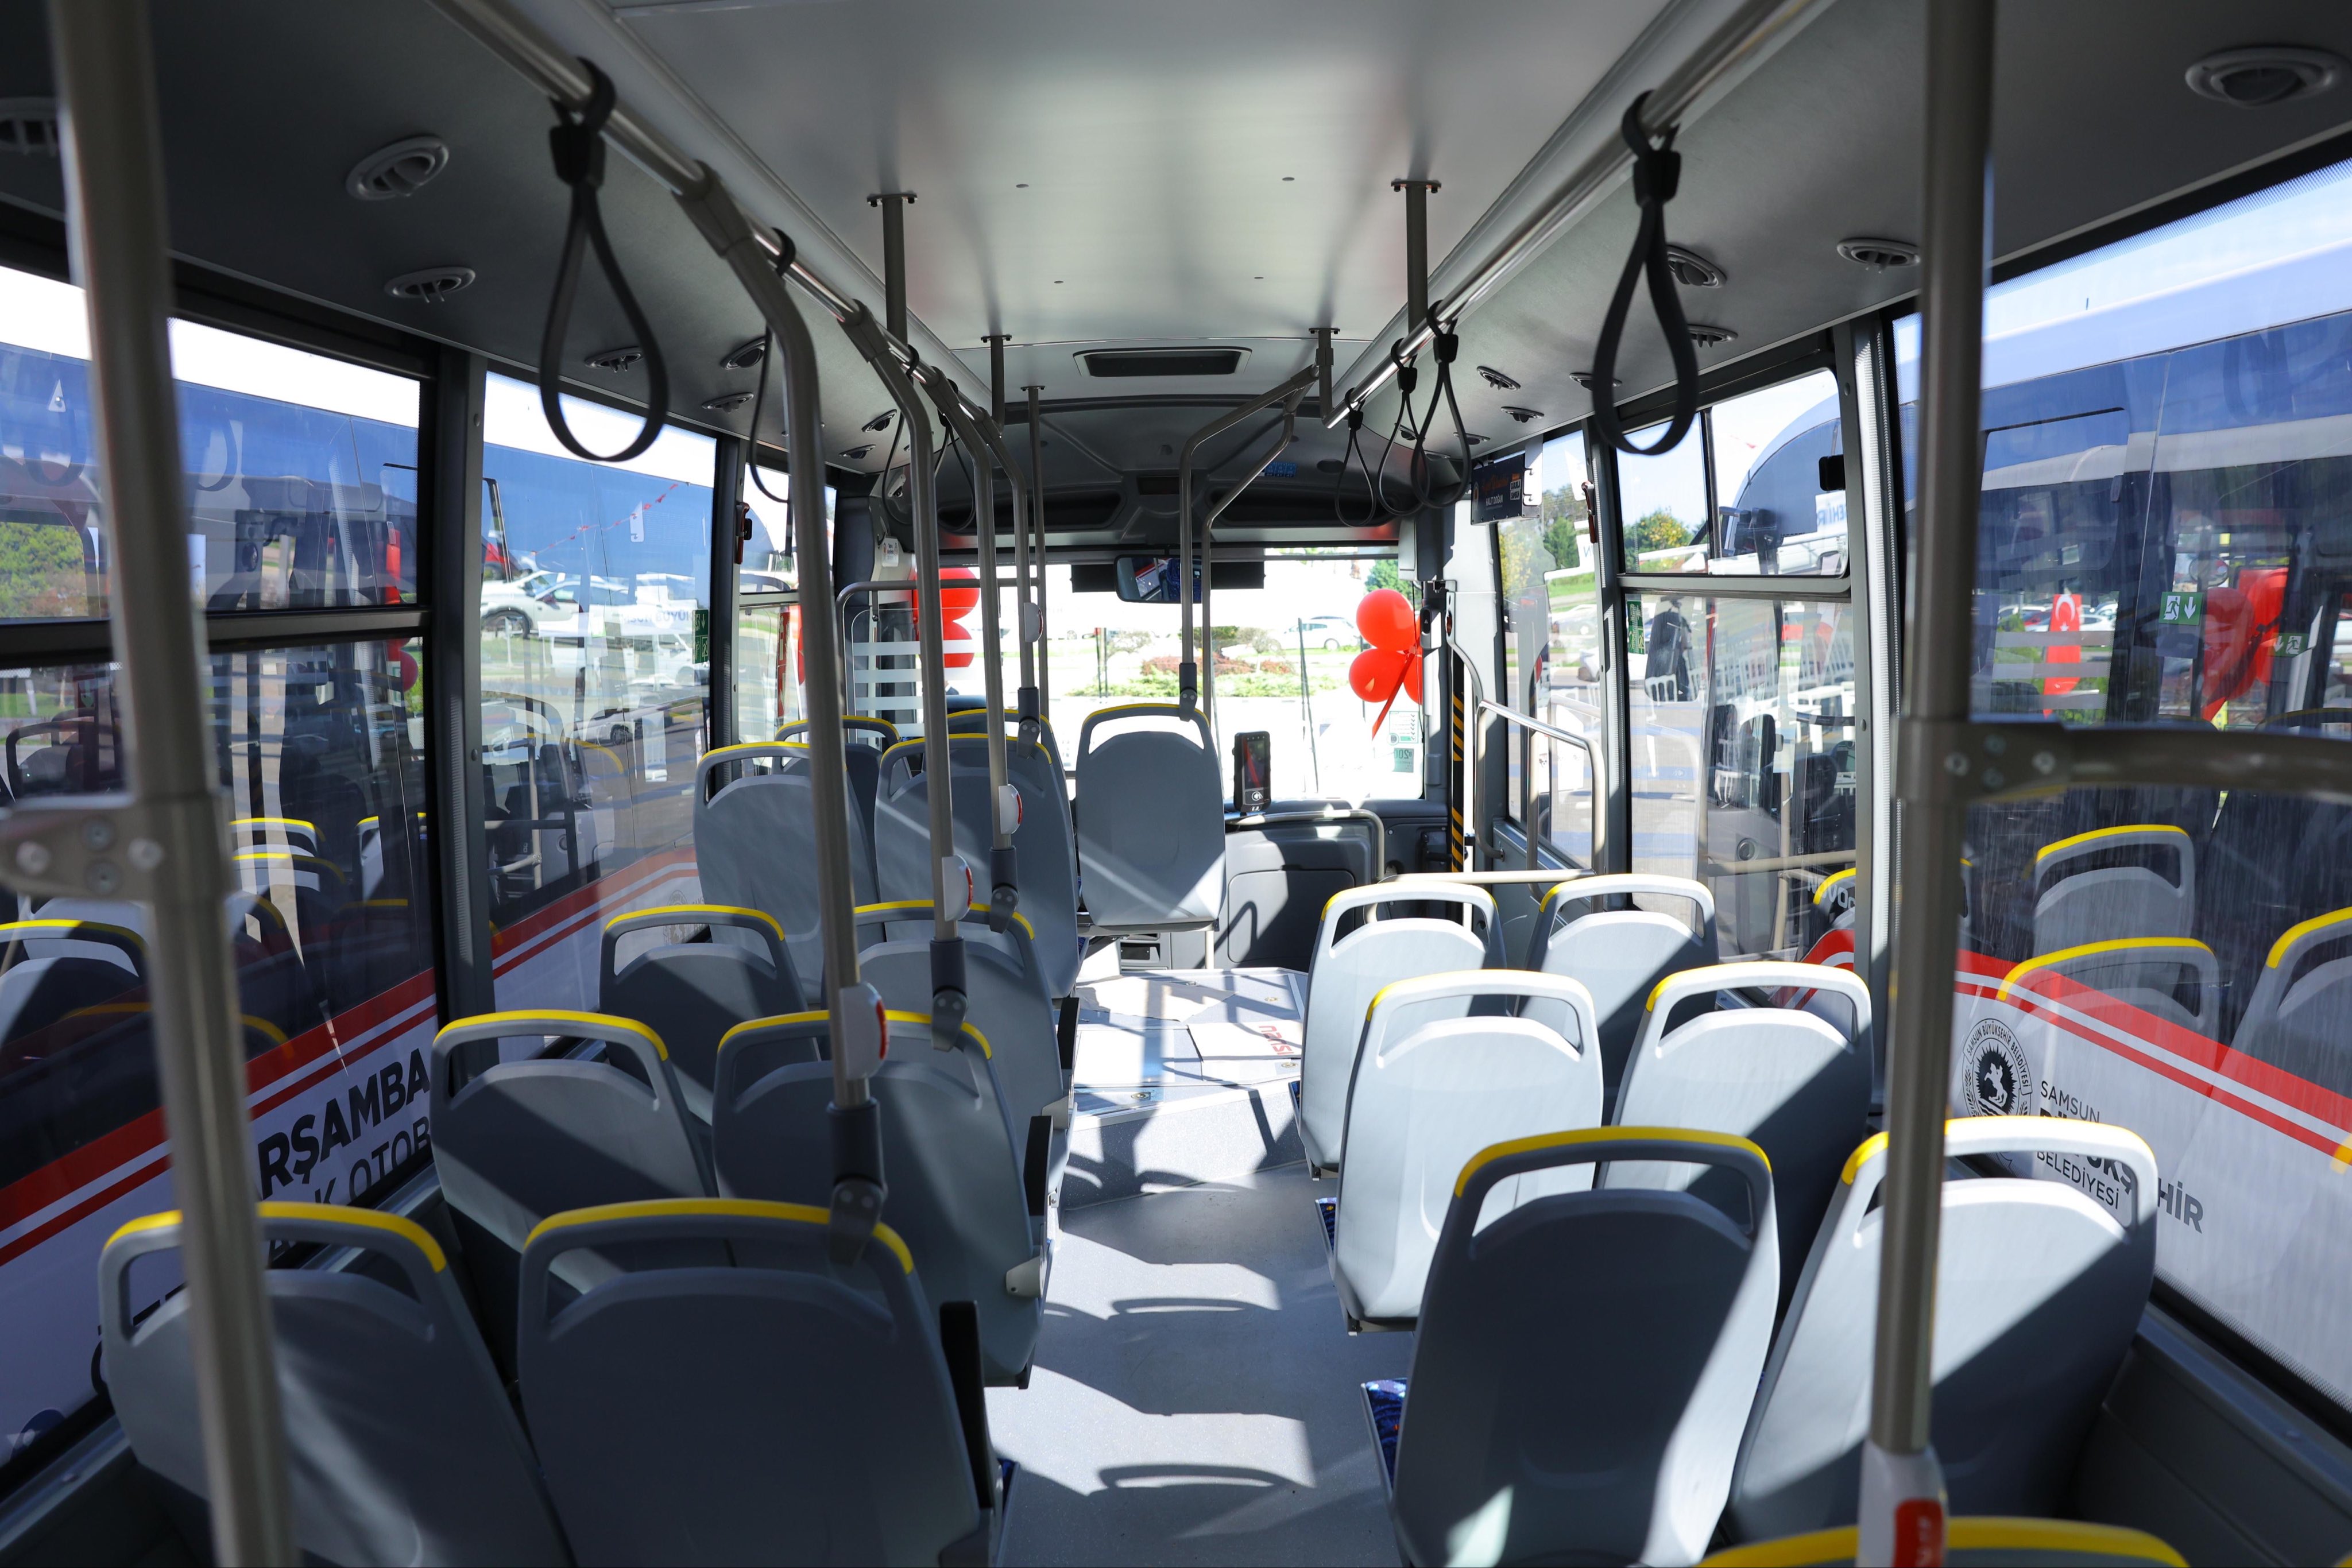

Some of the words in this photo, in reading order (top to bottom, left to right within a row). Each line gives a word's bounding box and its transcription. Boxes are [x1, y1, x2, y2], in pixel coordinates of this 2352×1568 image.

[1967, 1027, 1983, 1056] SAMSUN
[1982, 1020, 2011, 1046] BÜYÜKŞEHİR
[2010, 1042, 2032, 1087] BELEDİYESİ
[257, 1047, 431, 1200] RŞAMBA
[2040, 1080, 2100, 1124] SAMSUN
